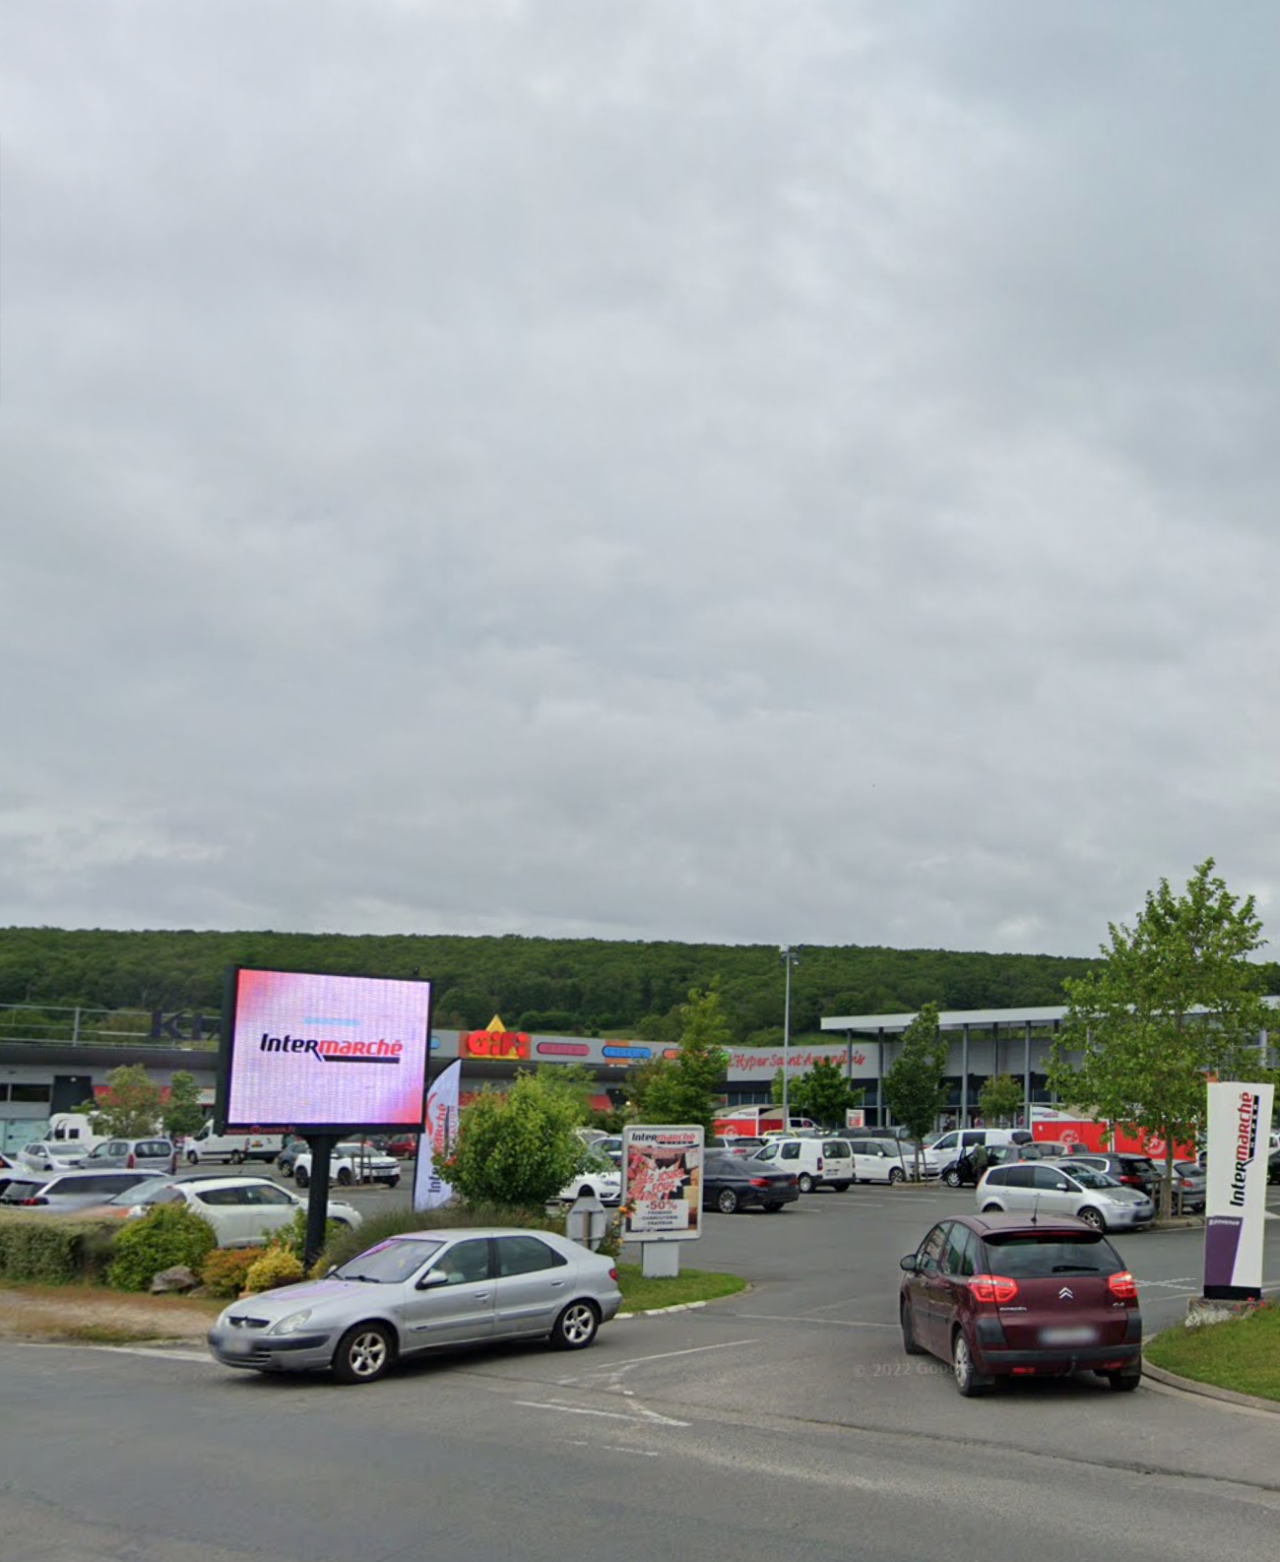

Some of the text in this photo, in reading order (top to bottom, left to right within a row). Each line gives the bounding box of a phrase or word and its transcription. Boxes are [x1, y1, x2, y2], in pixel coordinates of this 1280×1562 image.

[260, 1033, 403, 1062] Intermarché
[770, 1053, 803, 1067] Sant
[1229, 1091, 1254, 1207] Intermarché
